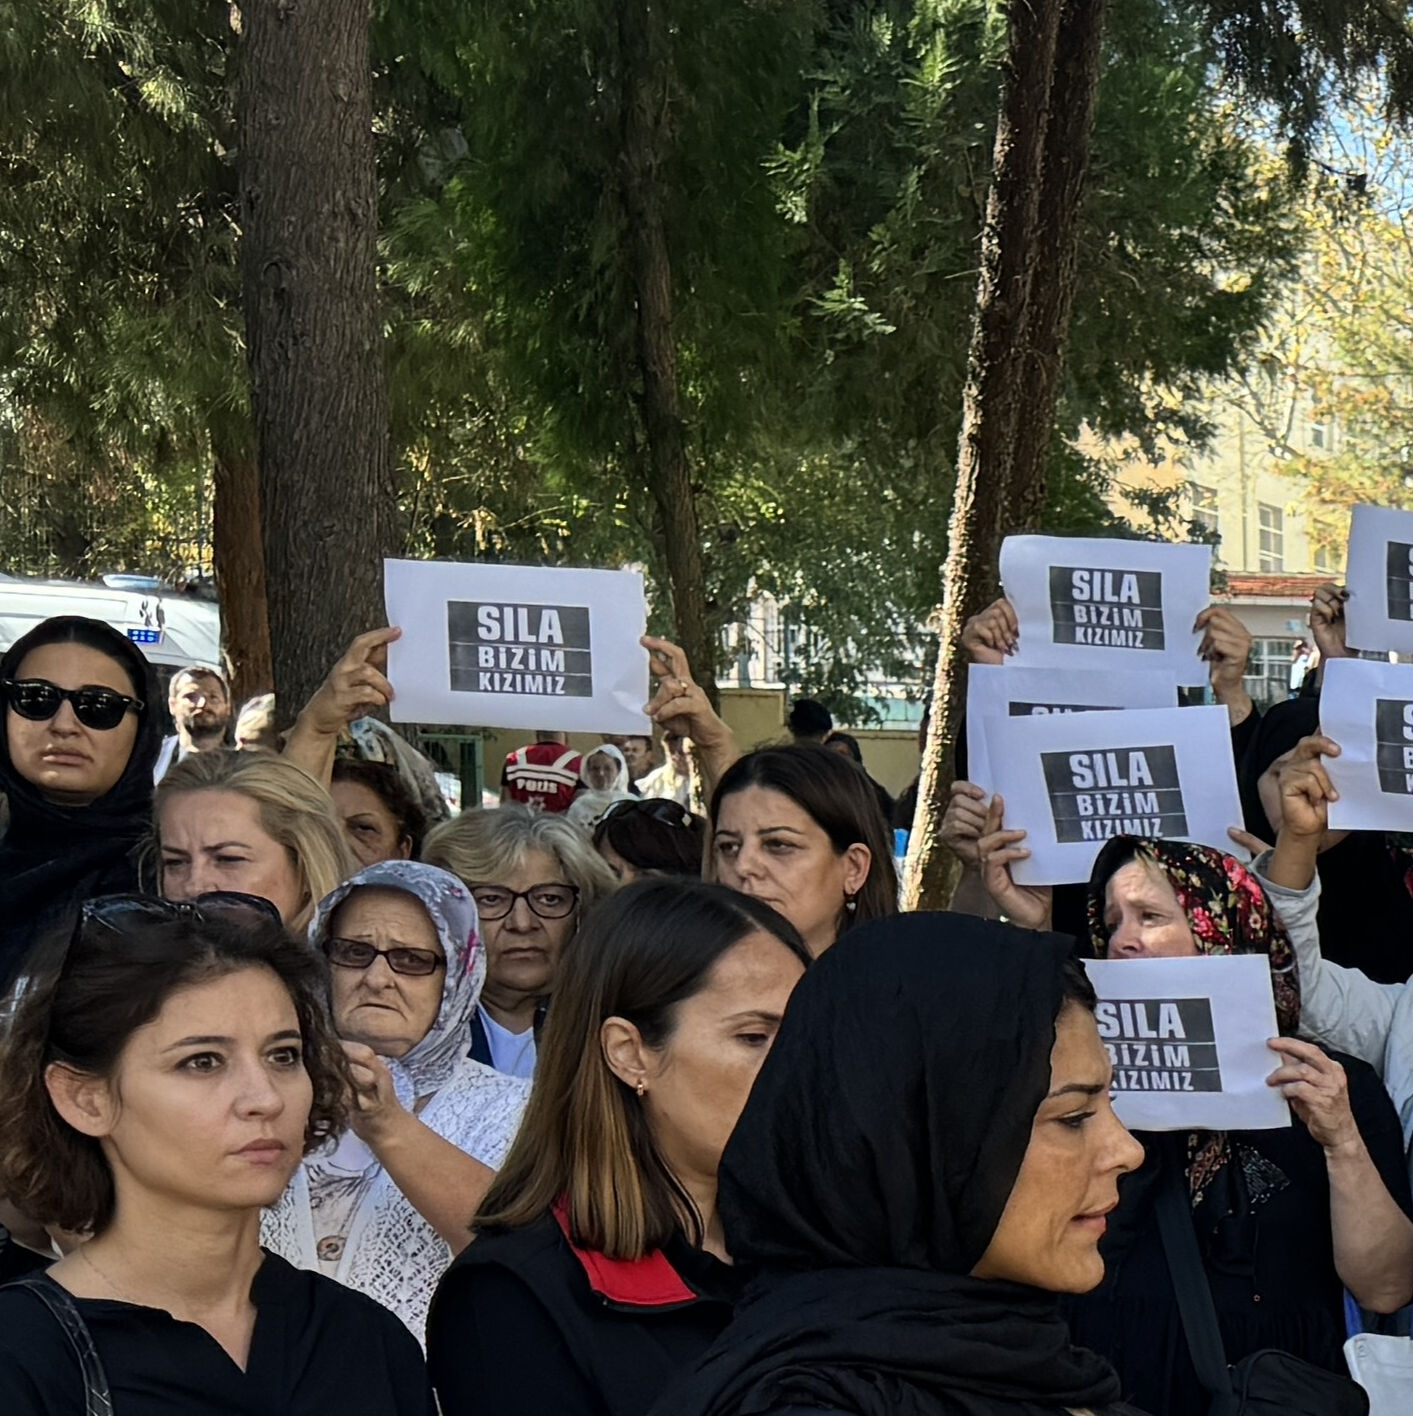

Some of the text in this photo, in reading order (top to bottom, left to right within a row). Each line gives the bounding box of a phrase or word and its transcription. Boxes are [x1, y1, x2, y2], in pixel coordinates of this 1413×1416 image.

[1071, 569, 1140, 604] SILA
[477, 605, 564, 645] SILA
[1074, 626, 1144, 648] KIZIMIZ
[478, 673, 566, 694] KIZIMIZ
[1069, 751, 1153, 788] SILA
[1097, 1002, 1186, 1038] SILA
